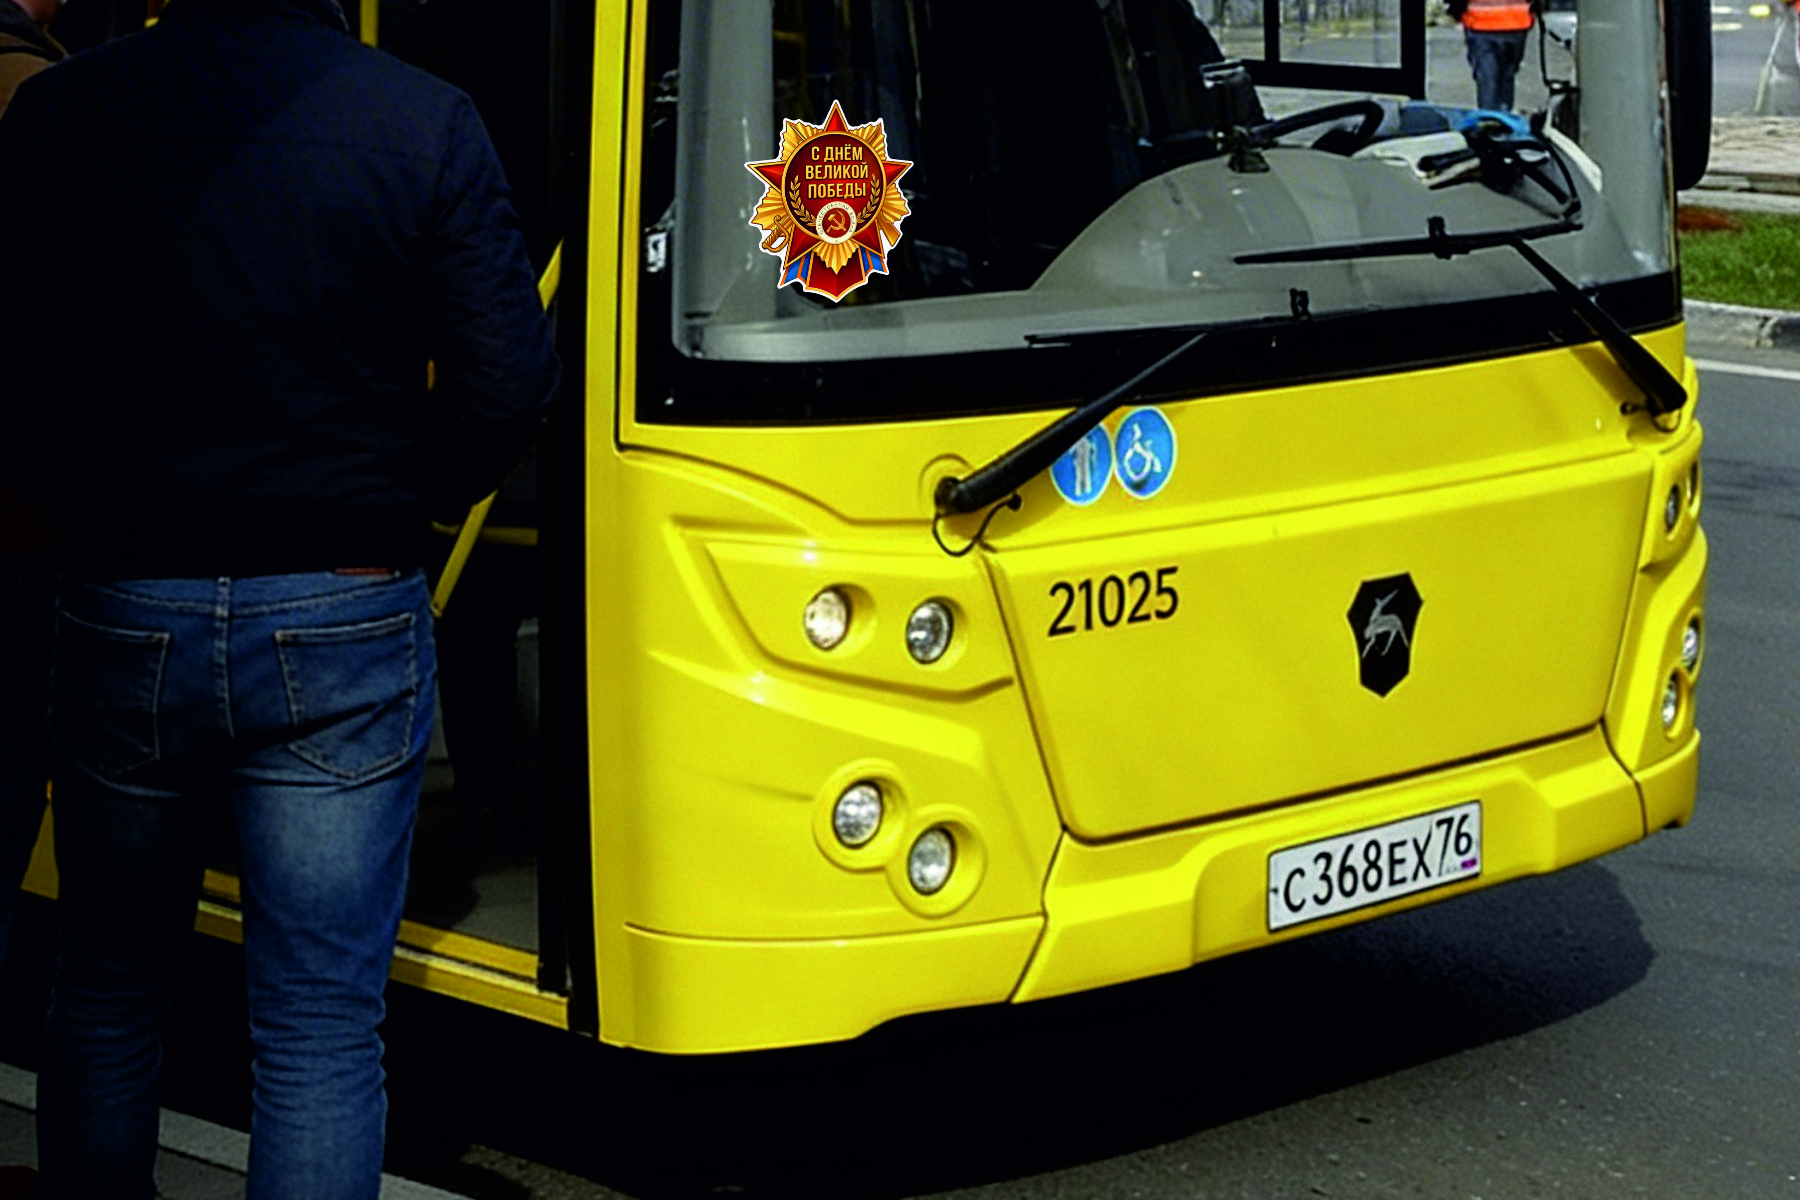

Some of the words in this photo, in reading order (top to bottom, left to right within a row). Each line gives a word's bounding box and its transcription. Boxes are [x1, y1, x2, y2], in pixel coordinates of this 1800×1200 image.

[811, 146, 820, 161] С
[823, 143, 863, 163] ДНЁМ
[805, 161, 869, 180] ВЕЛИКОЙ
[808, 182, 867, 200] ПОБЕДЫ
[1047, 565, 1179, 638] 21025
